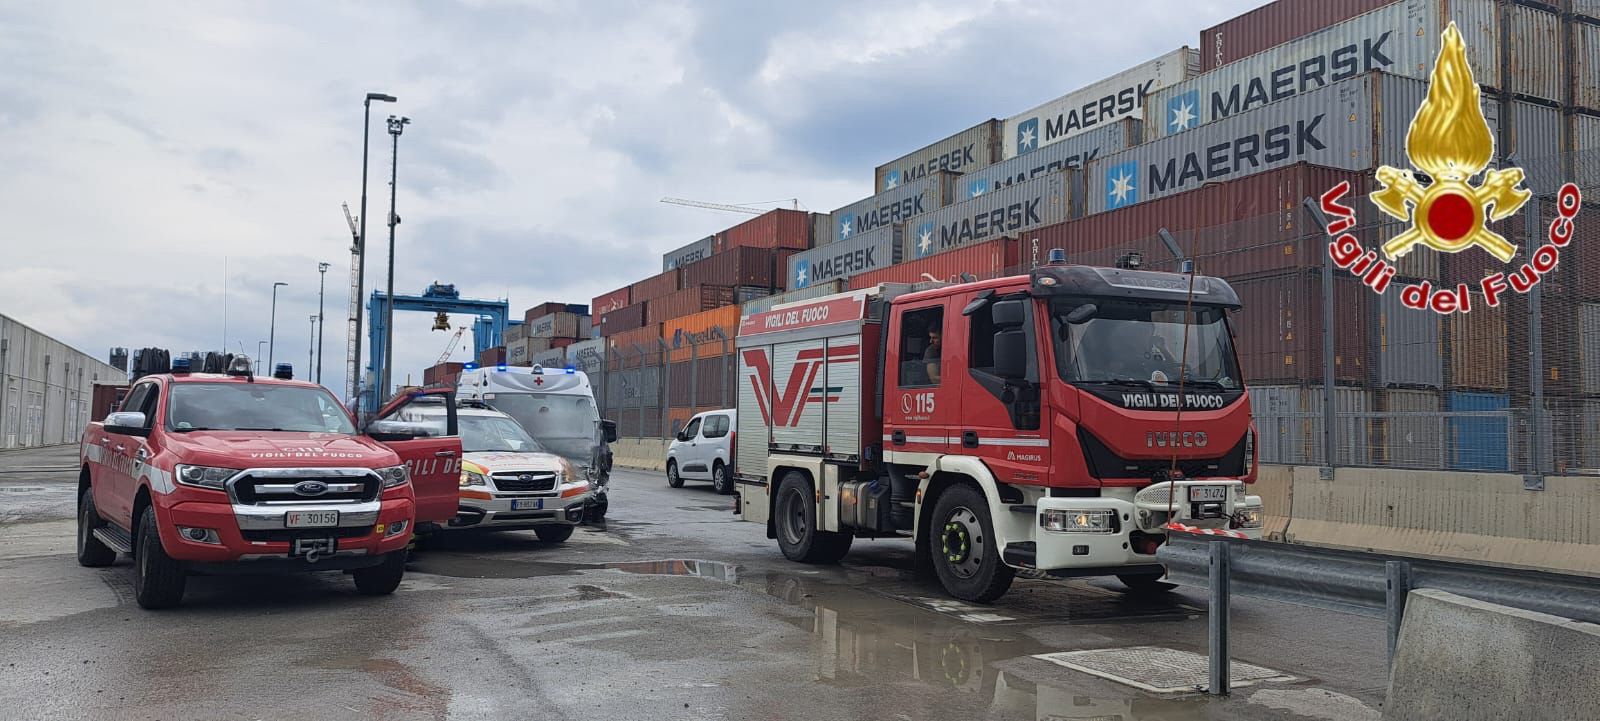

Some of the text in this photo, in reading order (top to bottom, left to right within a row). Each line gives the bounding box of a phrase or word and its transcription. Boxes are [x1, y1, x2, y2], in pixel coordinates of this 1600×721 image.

[1212, 30, 1394, 121] MAERSK
[1046, 79, 1154, 141] MAERSK
[904, 143, 975, 183] MAERSK
[1149, 113, 1327, 194] MAERSK
[857, 193, 924, 233] MAERSK
[940, 196, 1041, 248] MAERSK
[812, 245, 876, 282] MAERSK
[765, 314, 785, 329] VIGILI
[786, 311, 800, 326] DEL
[801, 305, 829, 324] FUOCO
[915, 392, 935, 413] 115
[1122, 394, 1157, 407] VIGILI
[1185, 395, 1223, 408] FUOCO
[1145, 431, 1208, 448] IVECO
[1016, 454, 1041, 462] MAGIRUS
[1192, 488, 1201, 498] VF
[289, 513, 336, 525] VF 30156
